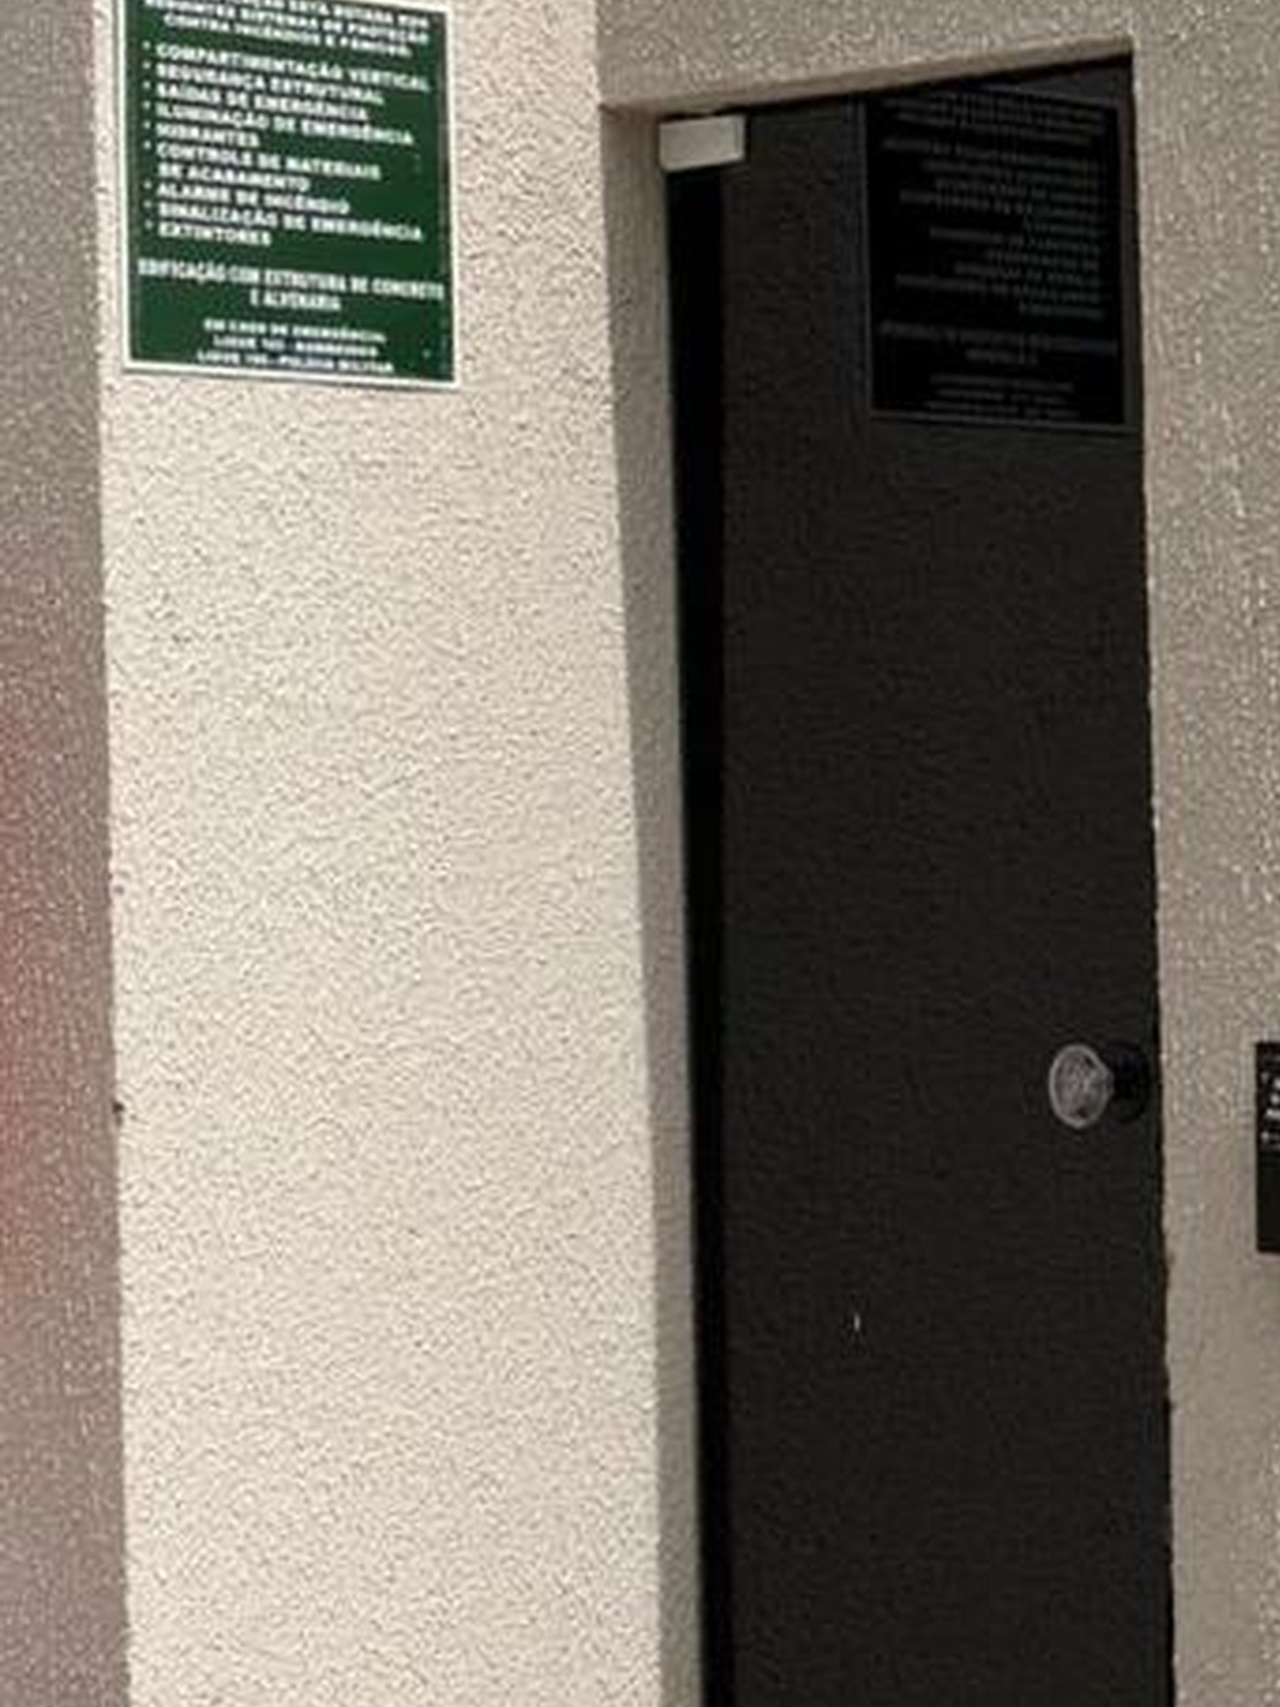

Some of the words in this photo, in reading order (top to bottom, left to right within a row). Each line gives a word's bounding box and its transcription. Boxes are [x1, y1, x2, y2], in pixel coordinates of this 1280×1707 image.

[349, 68, 430, 91] VERTICAL
[226, 91, 249, 107] DE
[274, 116, 296, 131] DE
[258, 153, 280, 169] DE
[235, 190, 259, 205] DE
[282, 213, 307, 229] DE
[351, 276, 368, 294] DE
